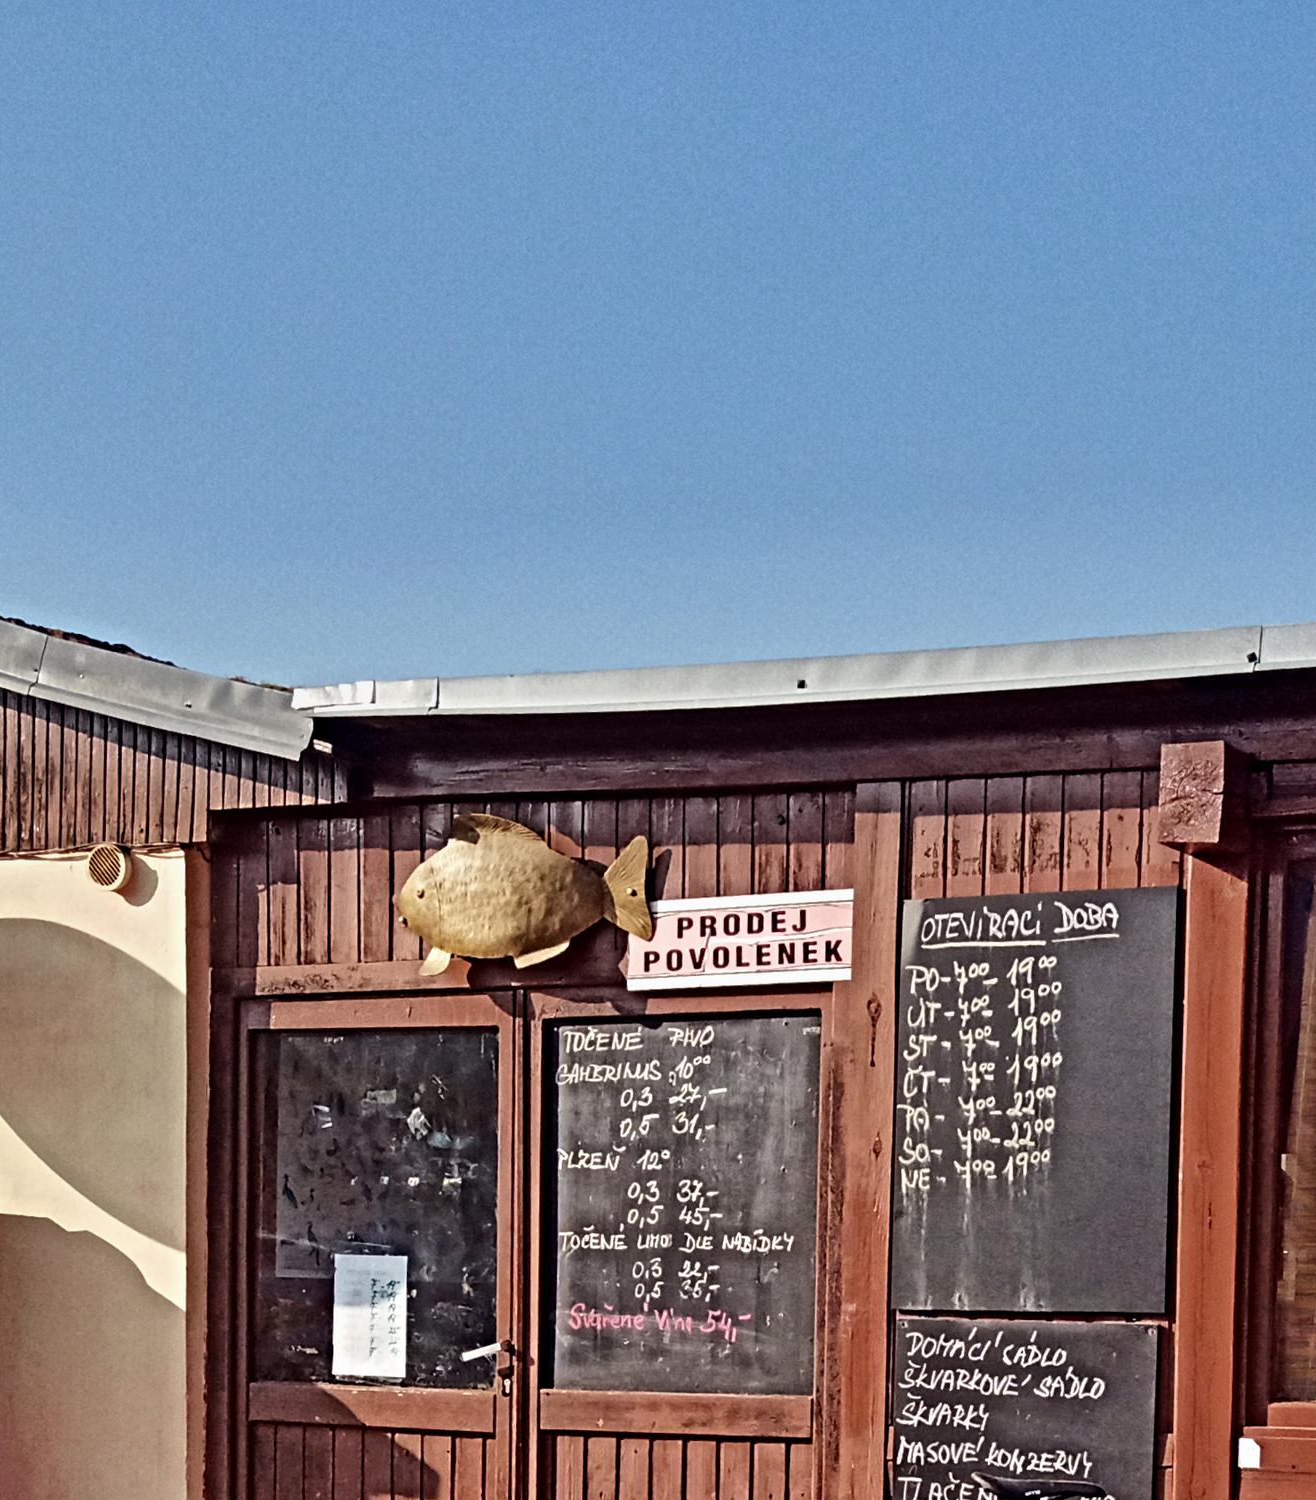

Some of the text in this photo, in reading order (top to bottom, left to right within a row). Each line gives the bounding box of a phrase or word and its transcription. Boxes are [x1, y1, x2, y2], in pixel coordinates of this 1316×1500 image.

[676, 909, 807, 939] PRODEJ
[1053, 901, 1119, 933] DOBA
[643, 939, 843, 973] POVOLENEK
[563, 1026, 715, 1053] TOČENÉ PIVO
[620, 1089, 652, 1112] 0,3
[620, 1114, 659, 1140] 0,5
[557, 1144, 626, 1170] PLZEŇ
[627, 1181, 660, 1205] 0,3
[627, 1205, 663, 1229] 0,5
[559, 1223, 627, 1251] TOČENÉ
[678, 1232, 713, 1253] DLE
[633, 1258, 662, 1280] 0,3
[634, 1281, 664, 1303] 0,5
[896, 1392, 989, 1430] ŠKVARKY
[896, 1436, 1093, 1478] MASOVÉ KONZERVY
